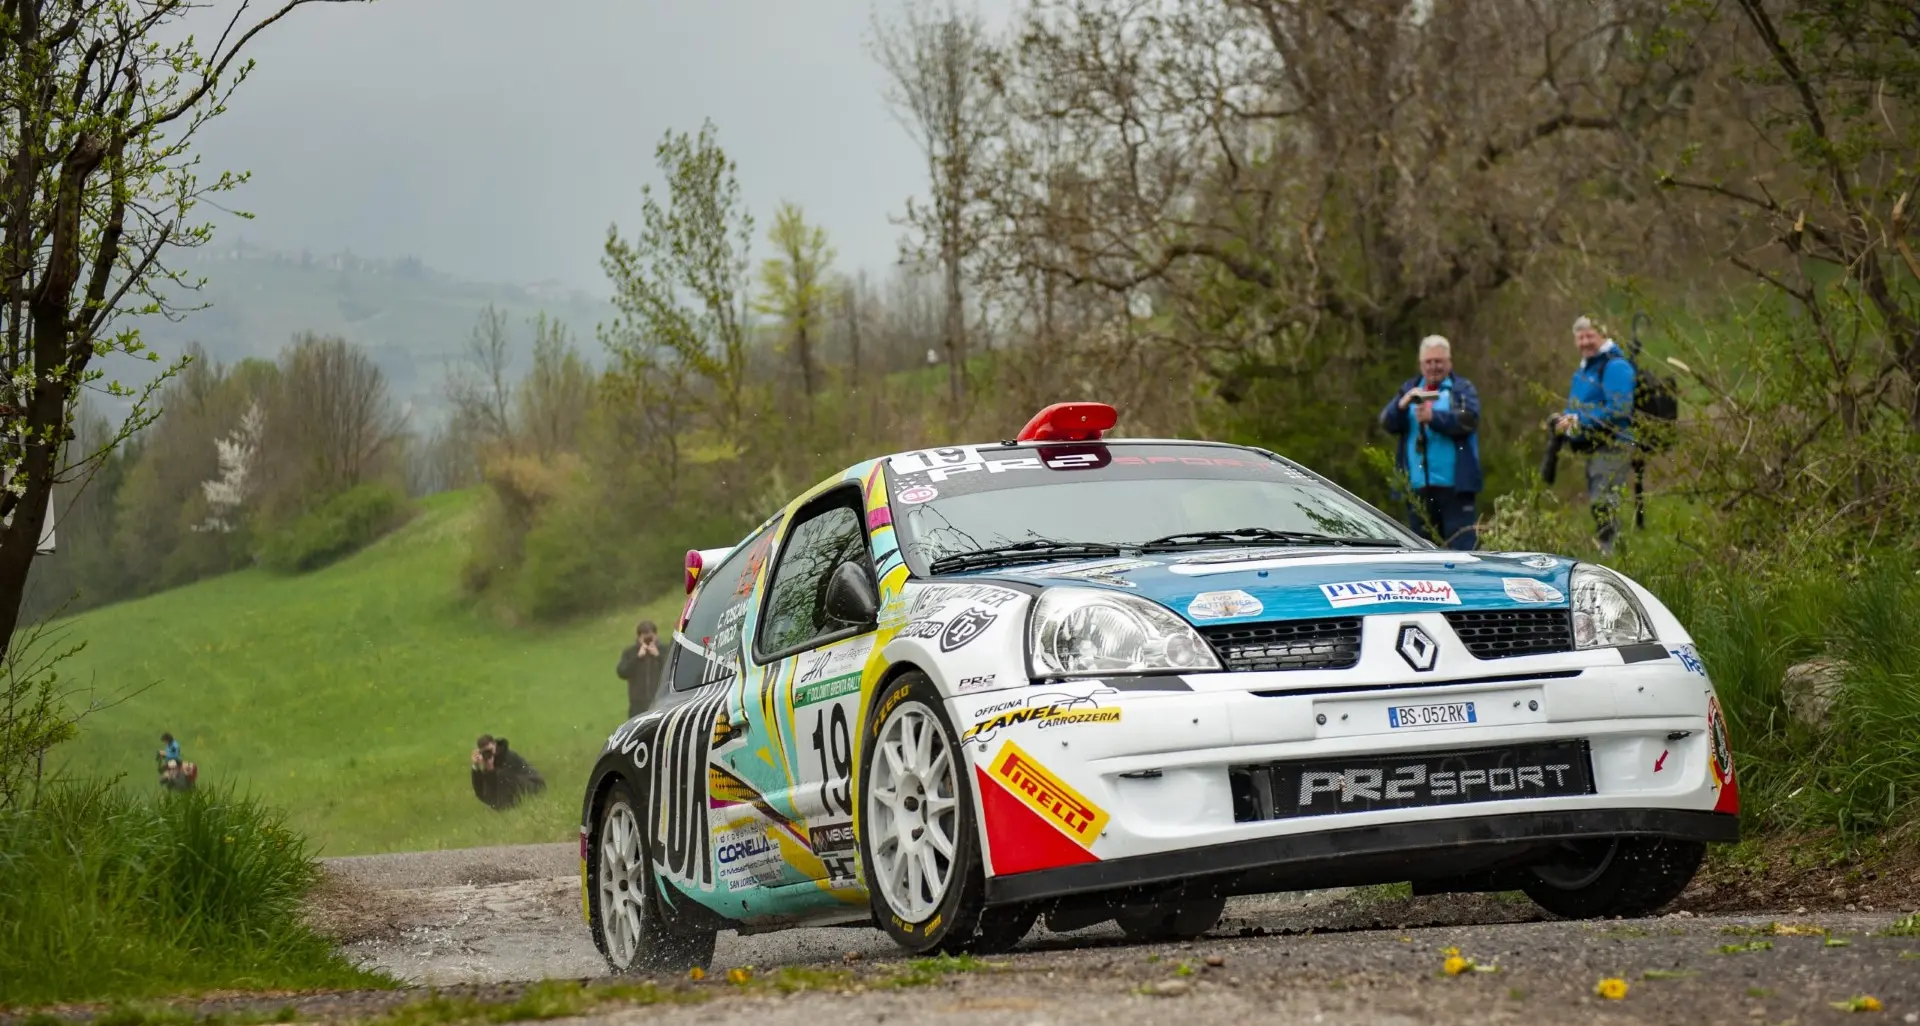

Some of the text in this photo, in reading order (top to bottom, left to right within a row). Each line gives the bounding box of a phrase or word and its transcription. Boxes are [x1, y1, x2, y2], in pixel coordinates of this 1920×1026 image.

[907, 448, 967, 467] 19
[927, 454, 1271, 482] PR2 SPORT
[972, 704, 1062, 735] TANEL
[974, 698, 1023, 718] OFFICINA
[1037, 712, 1121, 729] CARROZZERIA
[812, 702, 852, 817] 19
[1000, 753, 1095, 835] PIRELLI
[1299, 763, 1571, 806] PR2 SPORT
